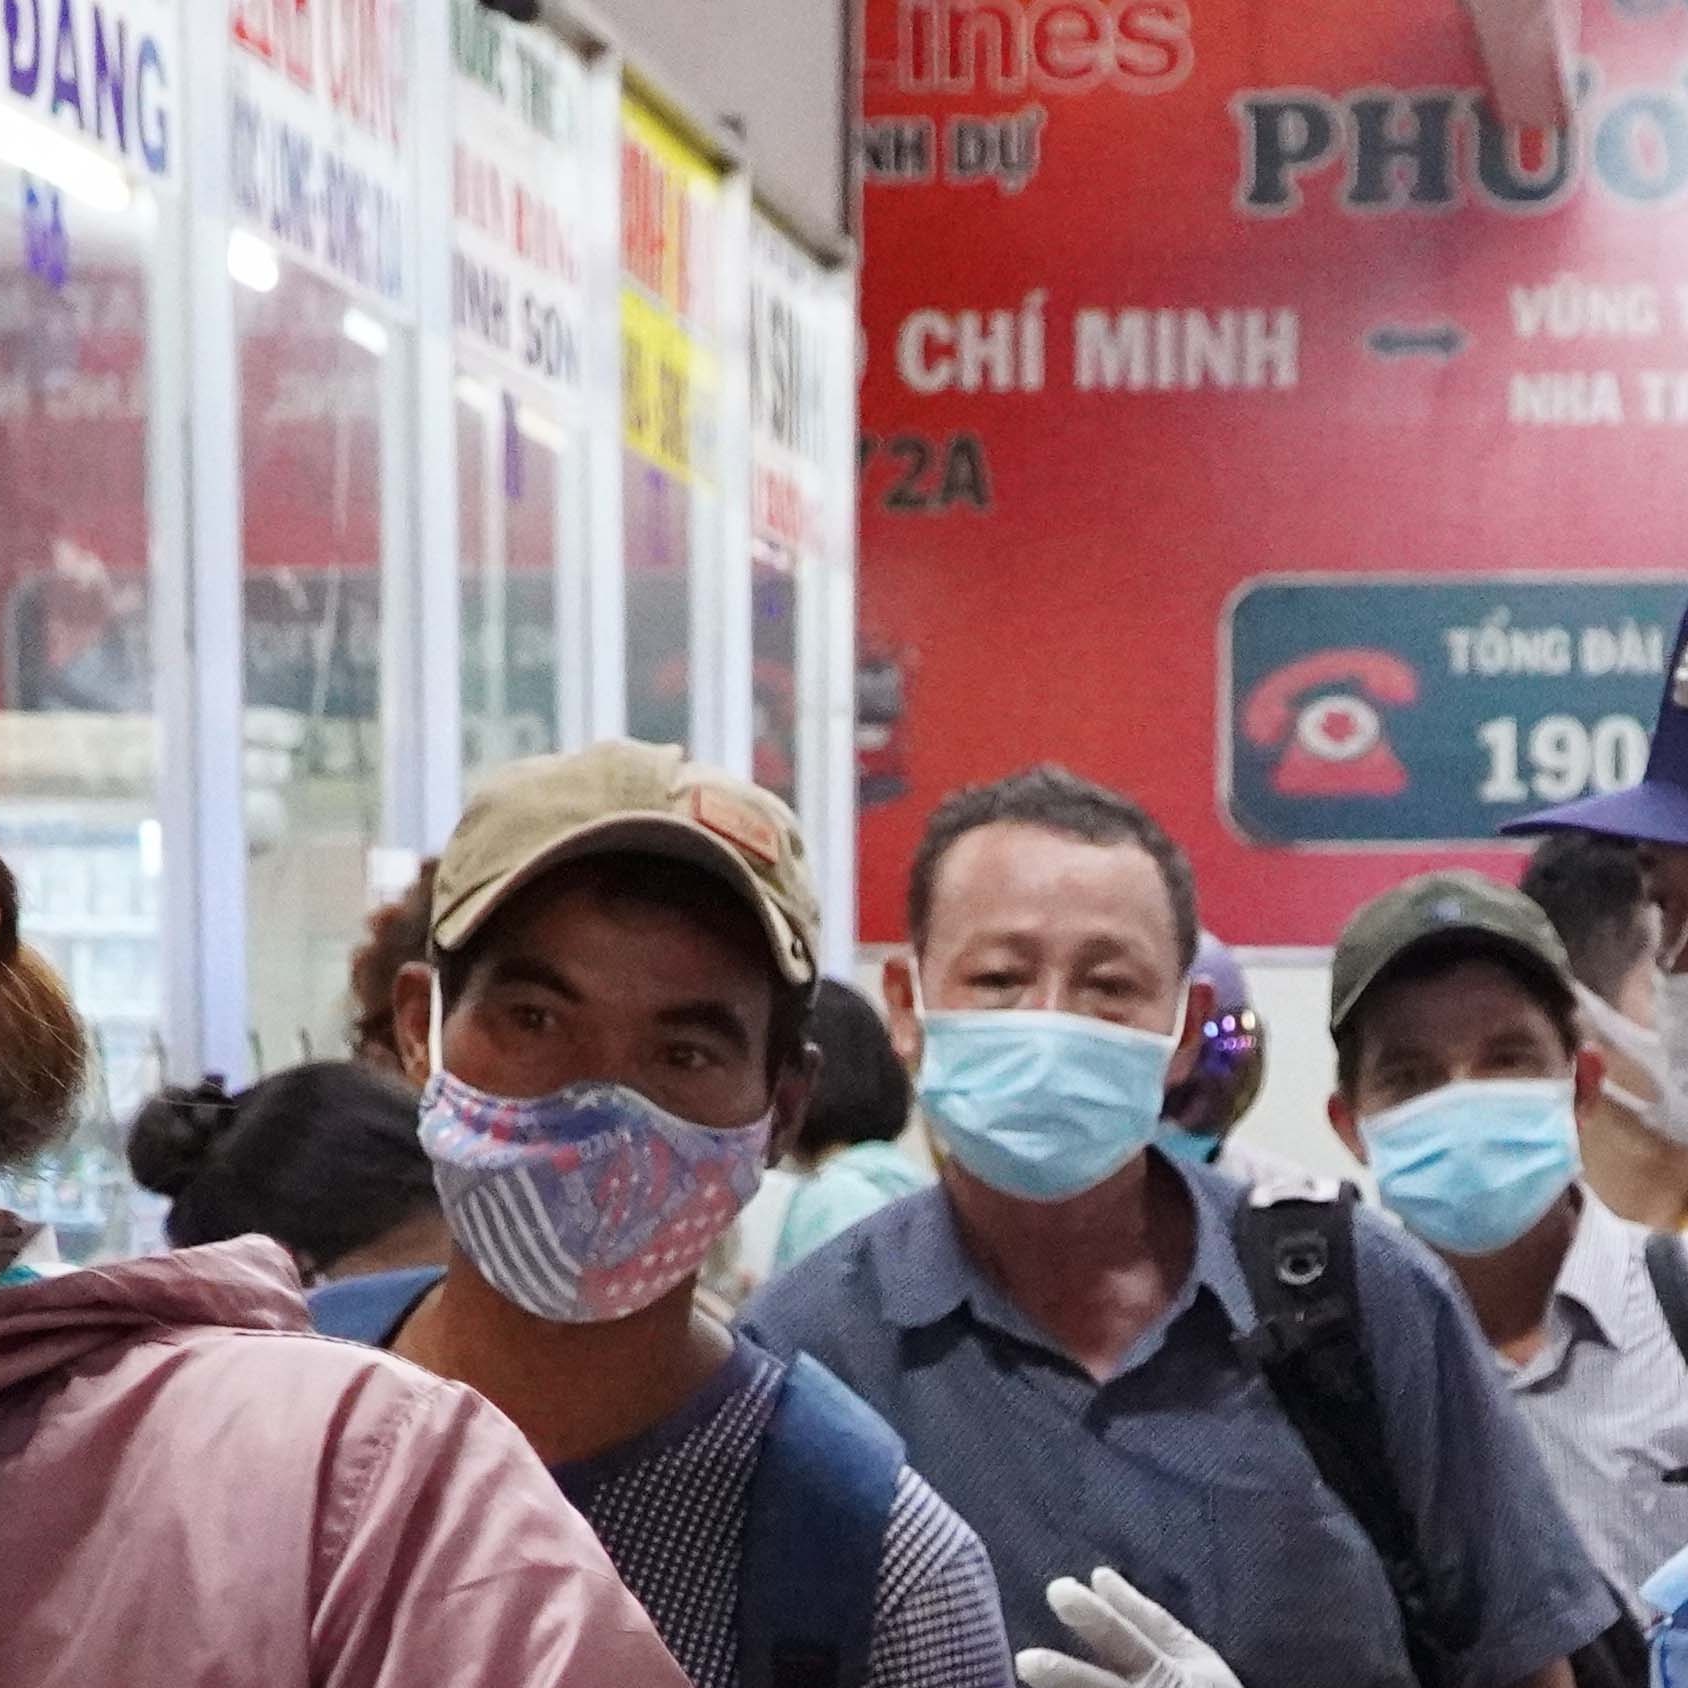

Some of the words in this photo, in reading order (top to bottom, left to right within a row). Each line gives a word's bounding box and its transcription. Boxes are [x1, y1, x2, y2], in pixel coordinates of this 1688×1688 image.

[898, 287, 1048, 396] CHÍ
[1073, 307, 1300, 394] MINH
[1508, 369, 1625, 427] NHA
